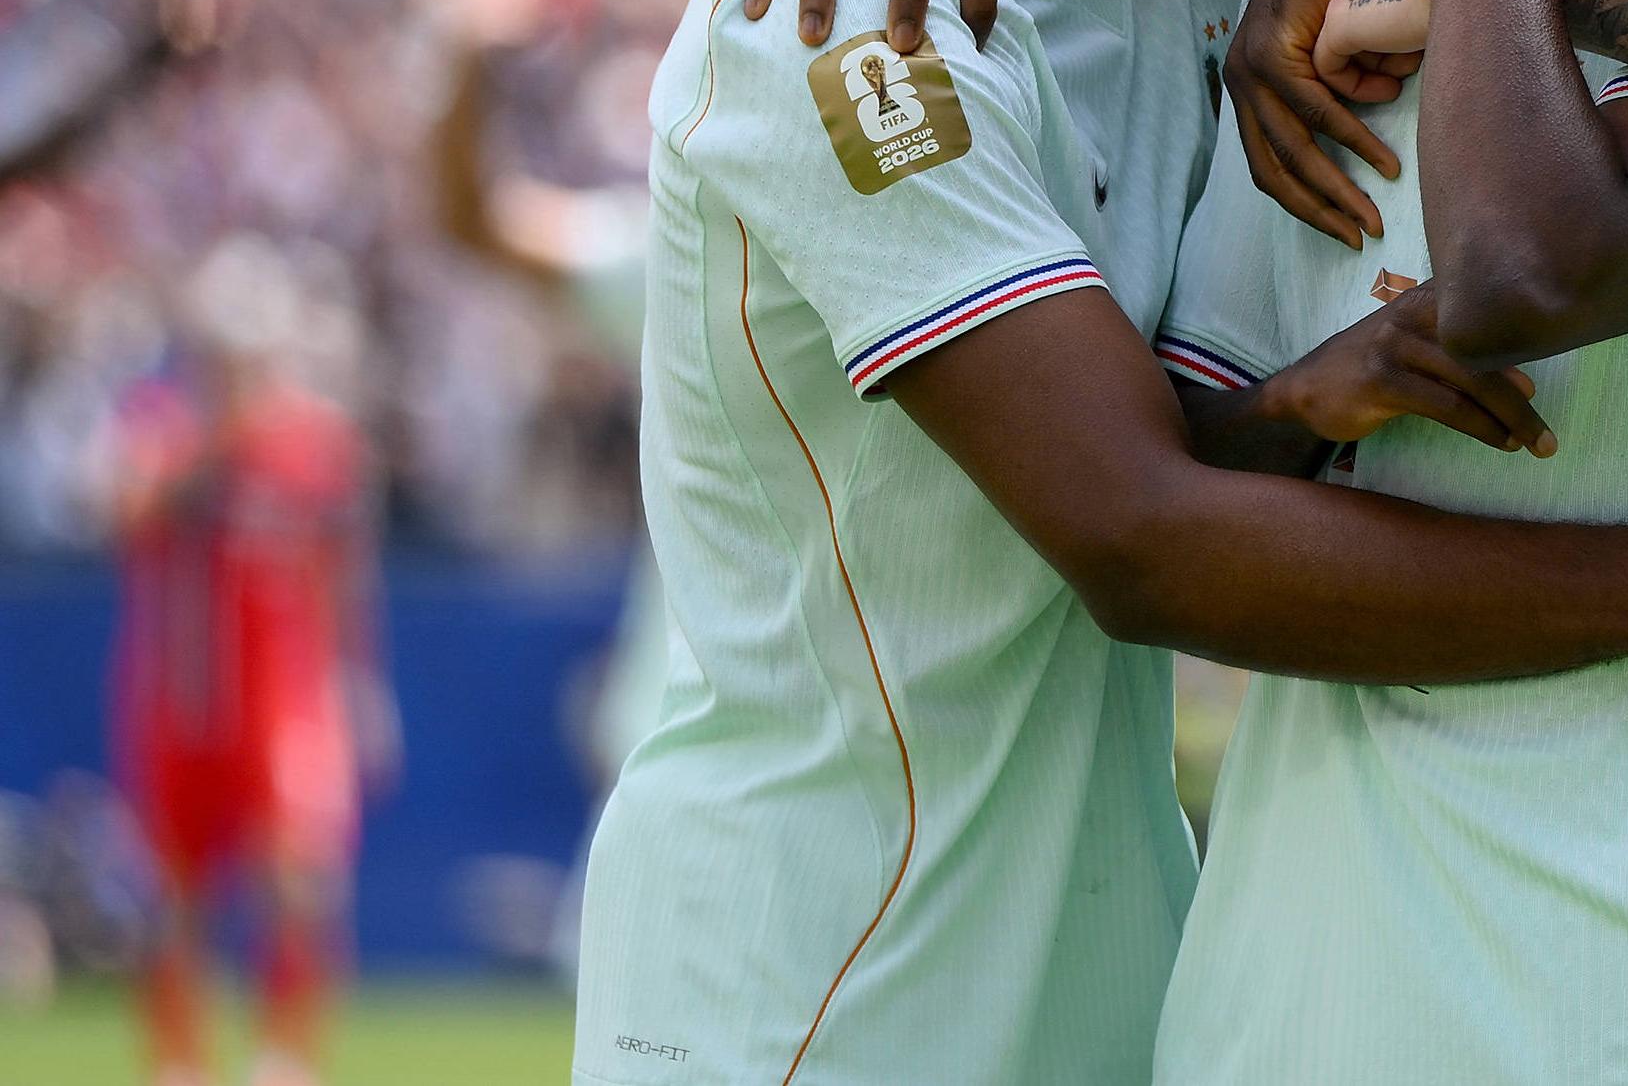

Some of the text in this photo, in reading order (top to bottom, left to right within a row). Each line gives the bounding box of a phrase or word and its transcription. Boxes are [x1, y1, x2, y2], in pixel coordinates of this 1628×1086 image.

[880, 113, 909, 130] FIFA
[873, 127, 934, 159] WORLD CUP
[878, 138, 940, 175] 2026
[615, 1034, 691, 1063] AERO-FIT
